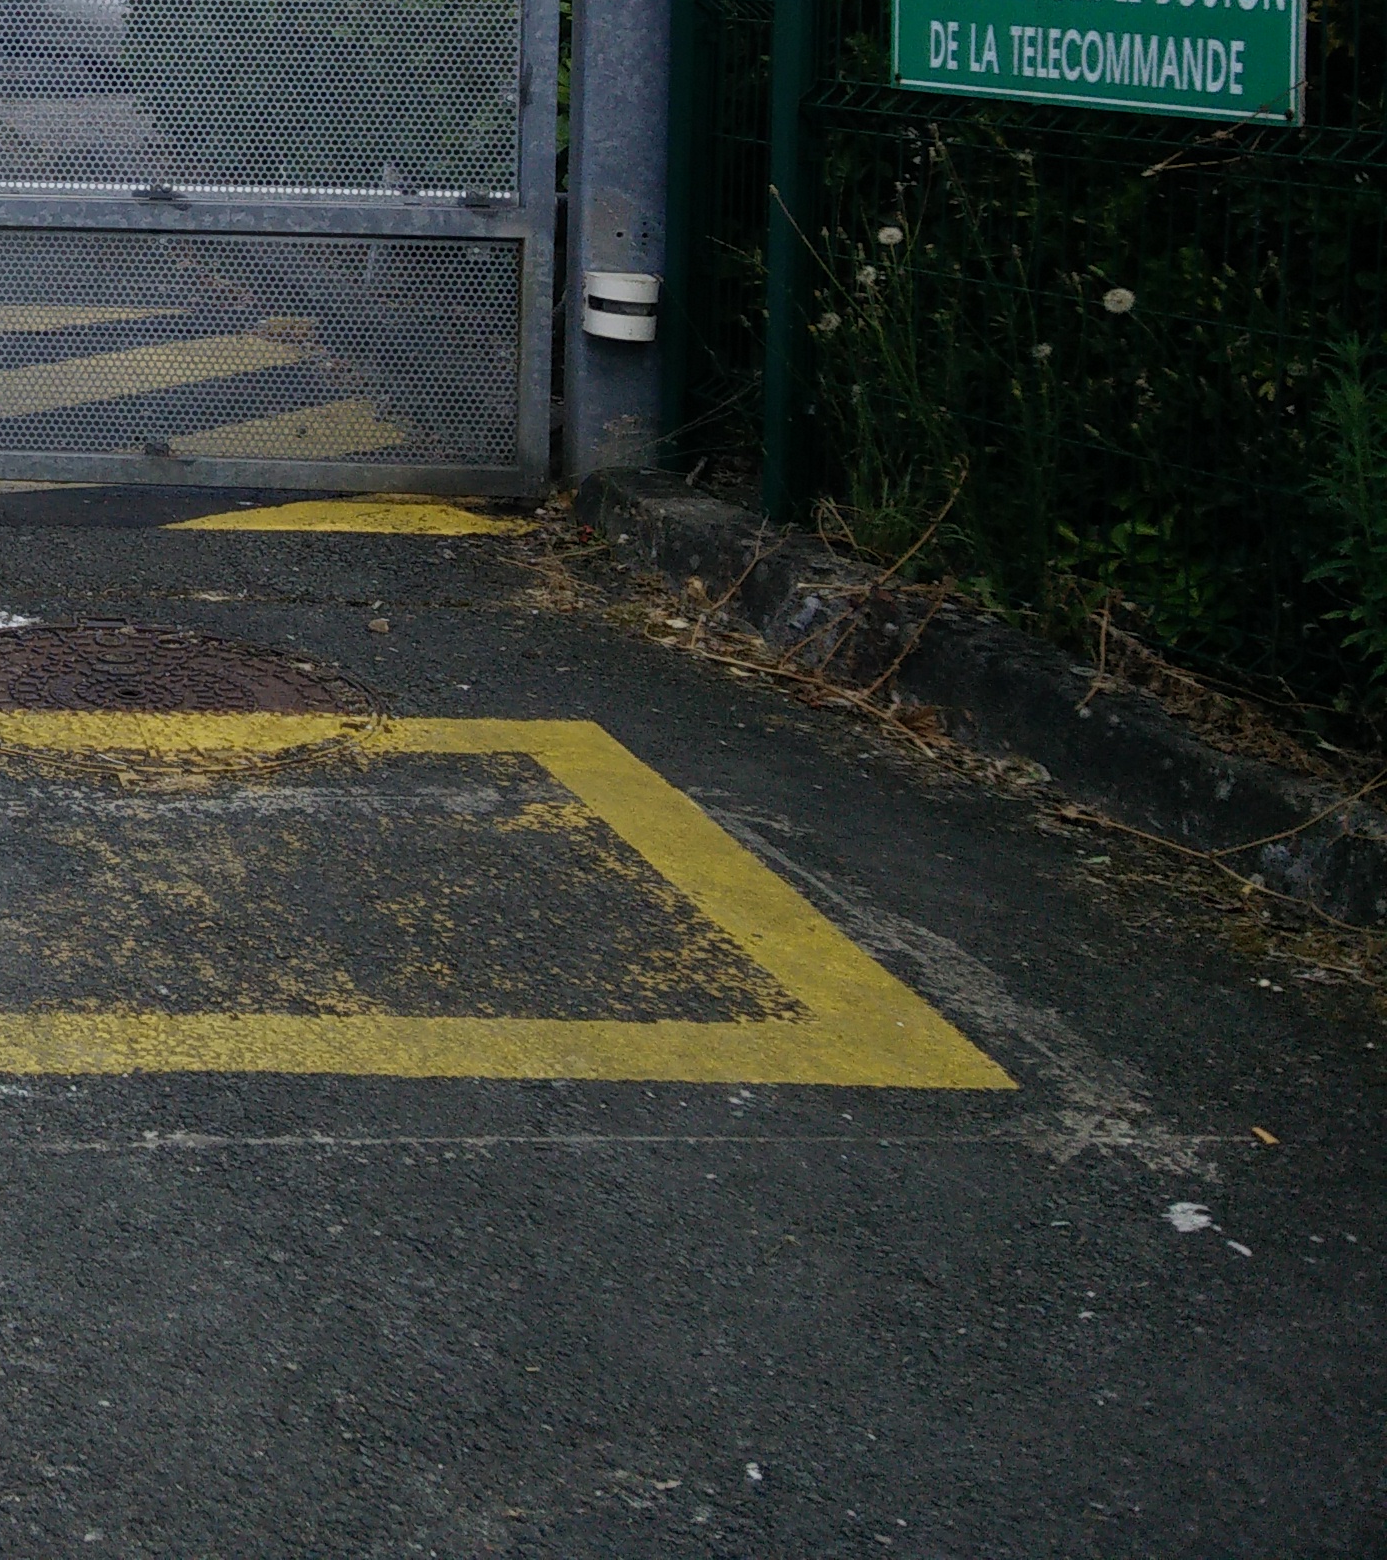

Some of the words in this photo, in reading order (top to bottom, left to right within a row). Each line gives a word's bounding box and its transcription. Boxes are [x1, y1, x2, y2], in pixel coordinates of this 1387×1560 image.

[931, 21, 958, 69] DE
[971, 24, 998, 73] LA
[1010, 26, 1245, 94] TELECOMMANDE
